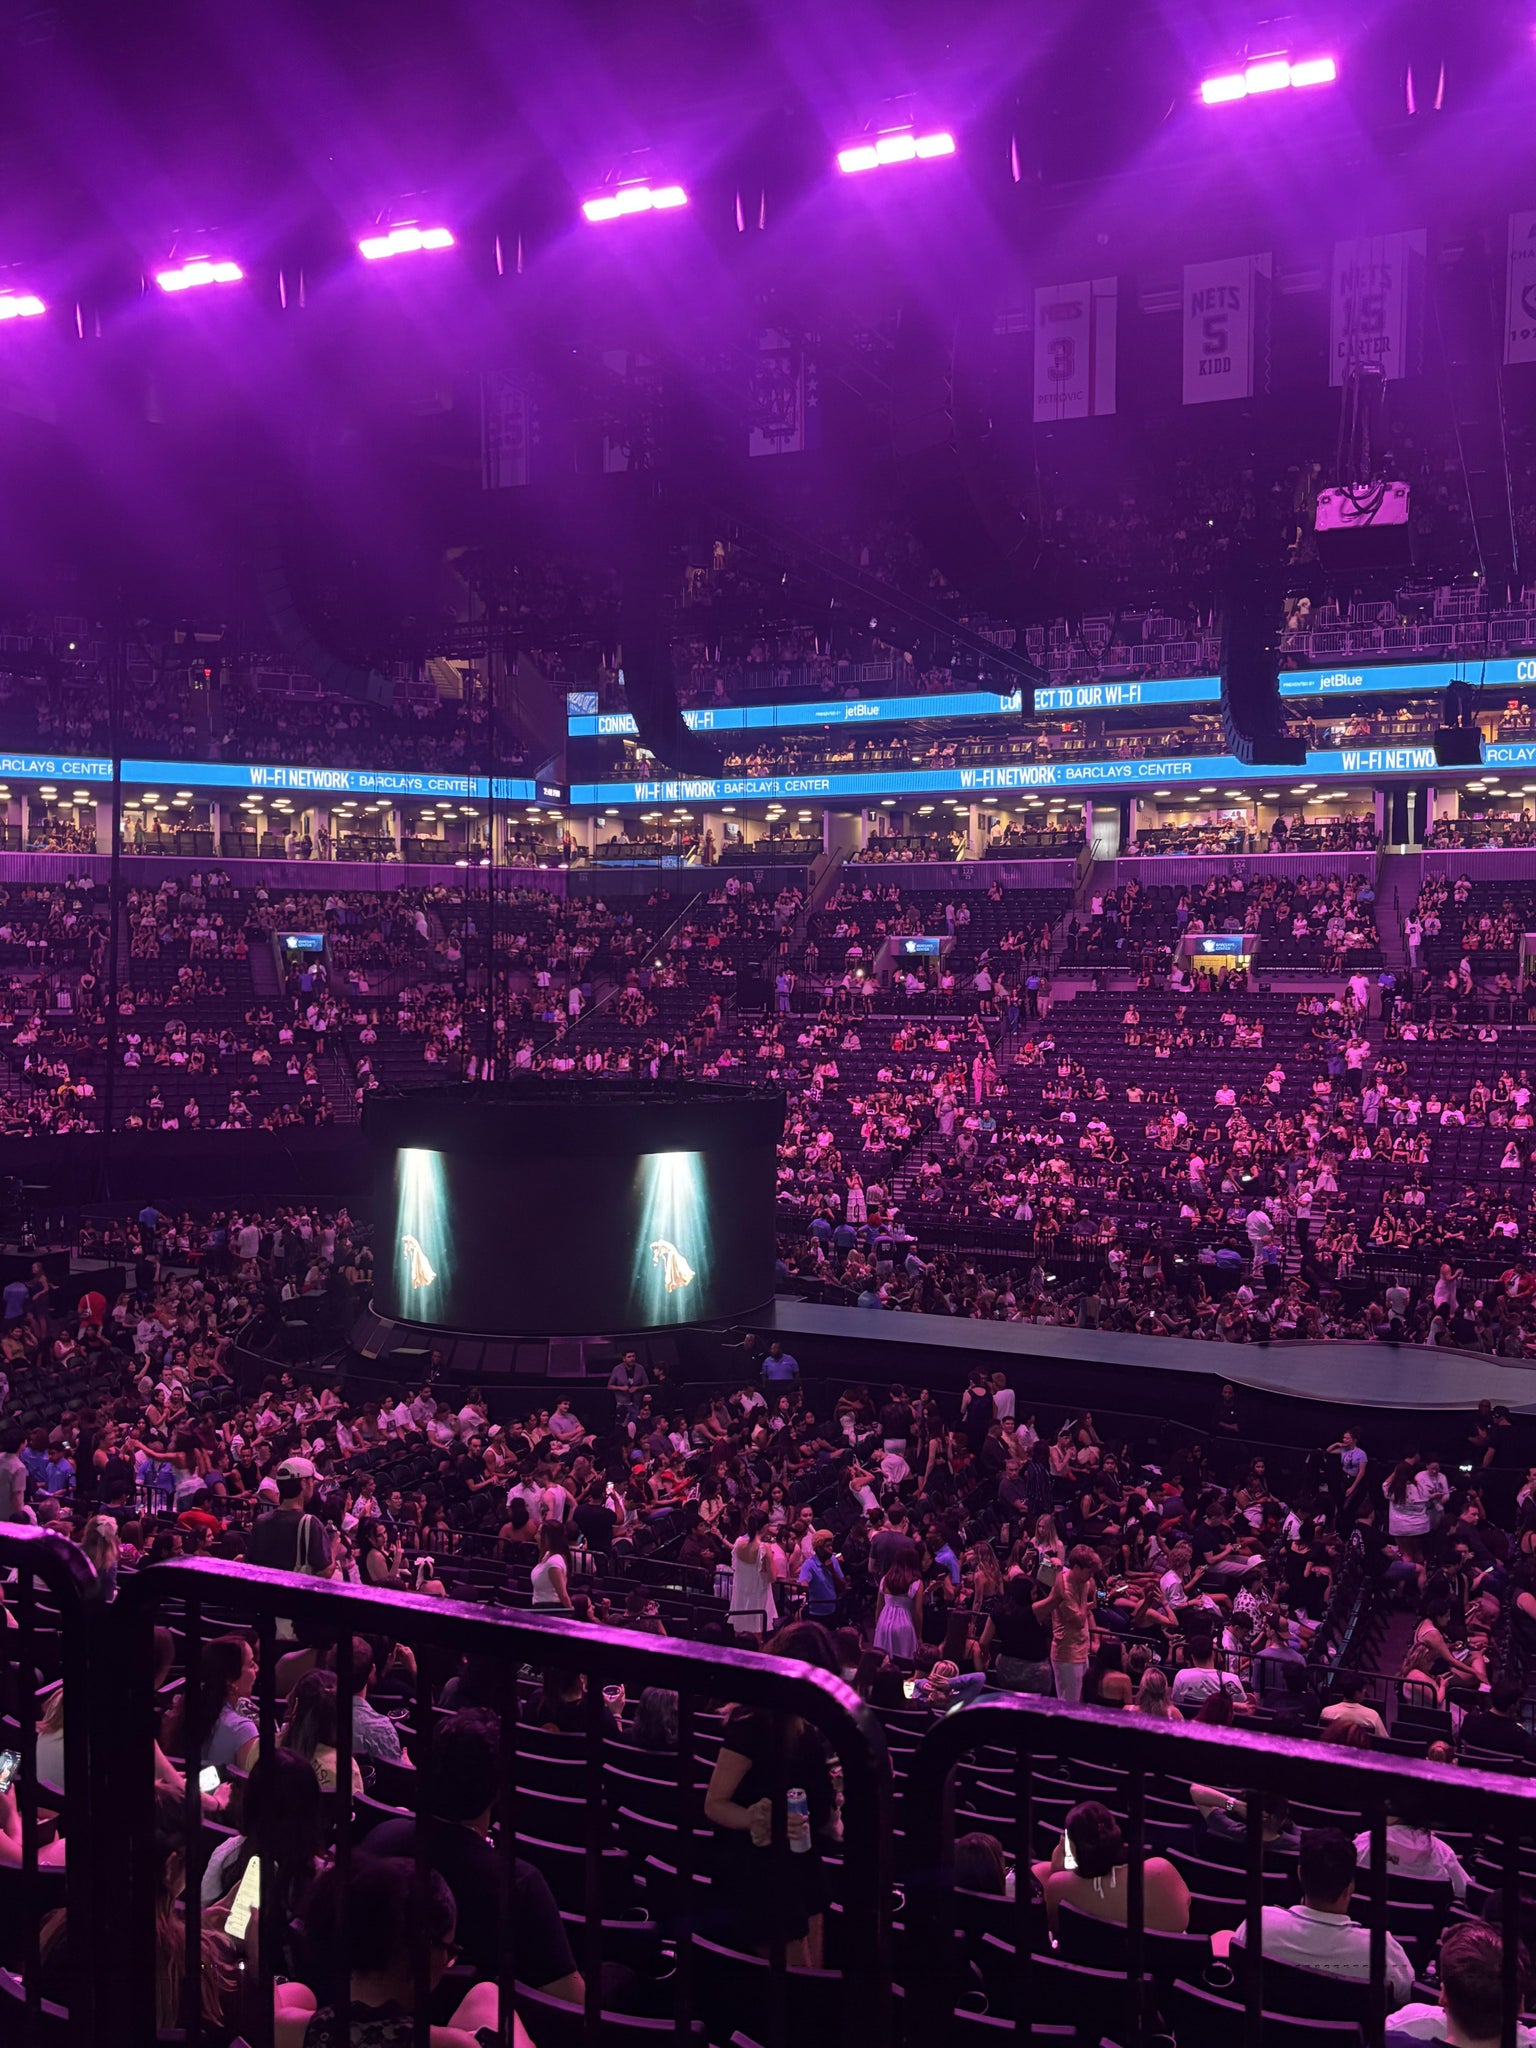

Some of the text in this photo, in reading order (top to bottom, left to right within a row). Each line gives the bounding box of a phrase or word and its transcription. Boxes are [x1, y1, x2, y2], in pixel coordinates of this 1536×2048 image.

[1340, 264, 1392, 296] NETS
[1192, 286, 1240, 319] NETS
[1344, 294, 1386, 336] 15
[1203, 313, 1228, 356] 5
[1047, 337, 1075, 382] 3
[1199, 357, 1231, 376] KIDD
[1038, 391, 1083, 404] PETROVIC
[1319, 674, 1362, 690] jetBlue
[1000, 685, 1141, 711] CONECT TO OUR WI-FI
[844, 704, 880, 720] jetBlue
[598, 717, 639, 733] CONNE
[1342, 750, 1434, 770] WI-FI NETWO
[250, 768, 477, 792] WI-FI NETWORK: BARCLAYS_CENTER
[960, 763, 1191, 787] WI-FI NETWORK: BARCLAYS_CENTER
[634, 784, 664, 800] WI-FI
[724, 779, 829, 794] BARCLAYS_CENTER
